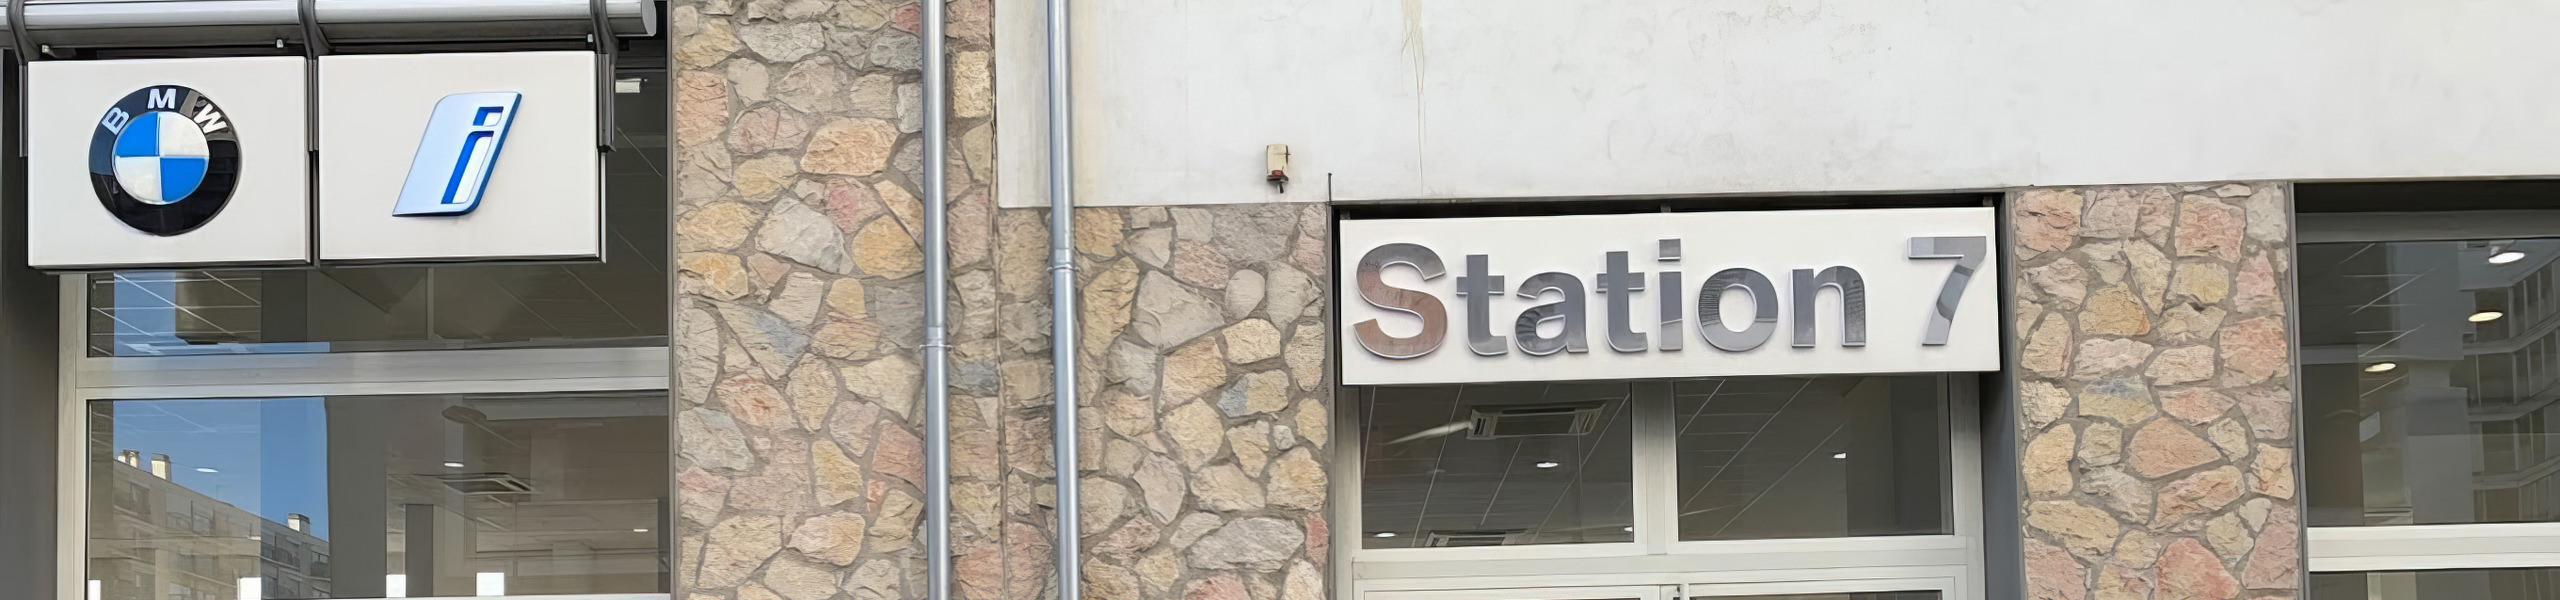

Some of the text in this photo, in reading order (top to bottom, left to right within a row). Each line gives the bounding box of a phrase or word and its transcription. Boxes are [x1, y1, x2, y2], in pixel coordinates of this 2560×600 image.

[101, 88, 228, 135] BMW
[440, 106, 504, 204] i
[1353, 236, 1987, 359] Station 7
